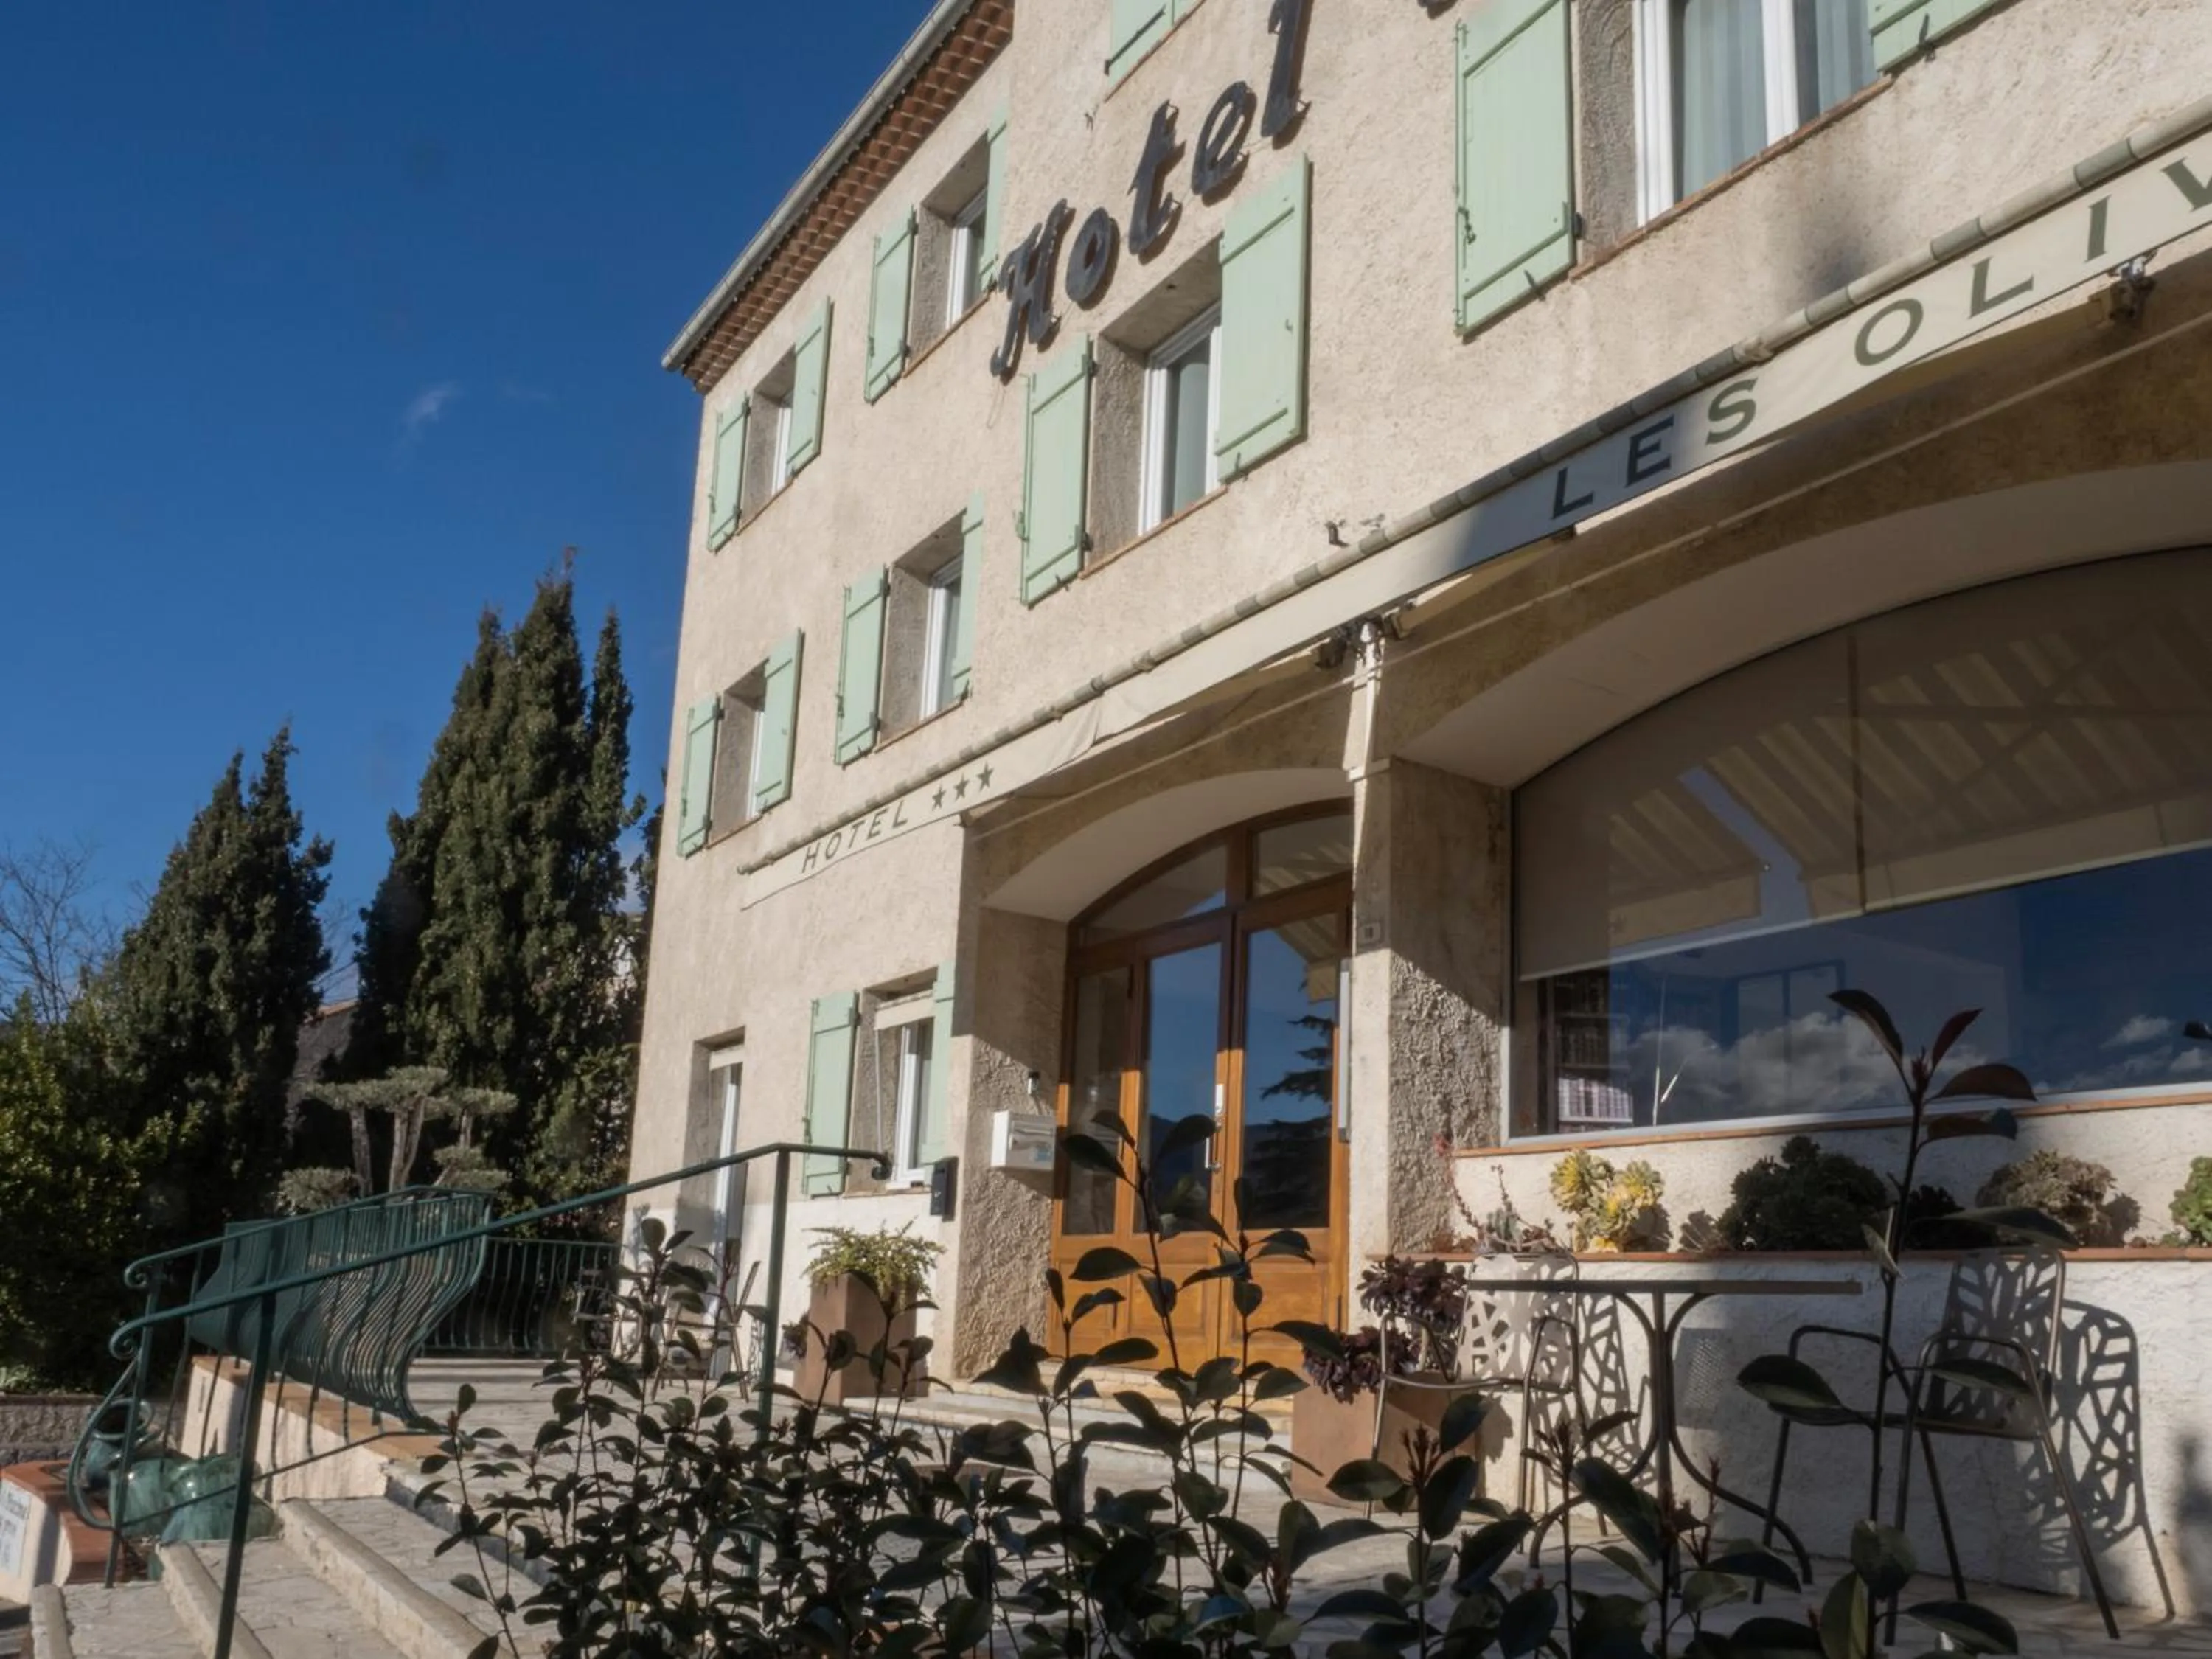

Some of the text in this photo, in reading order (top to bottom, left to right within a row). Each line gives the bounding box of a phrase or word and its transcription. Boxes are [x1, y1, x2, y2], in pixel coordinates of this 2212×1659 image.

[990, 0, 1310, 377] Hotel
[801, 799, 908, 874] HOTEL
[1551, 378, 1758, 521] LES
